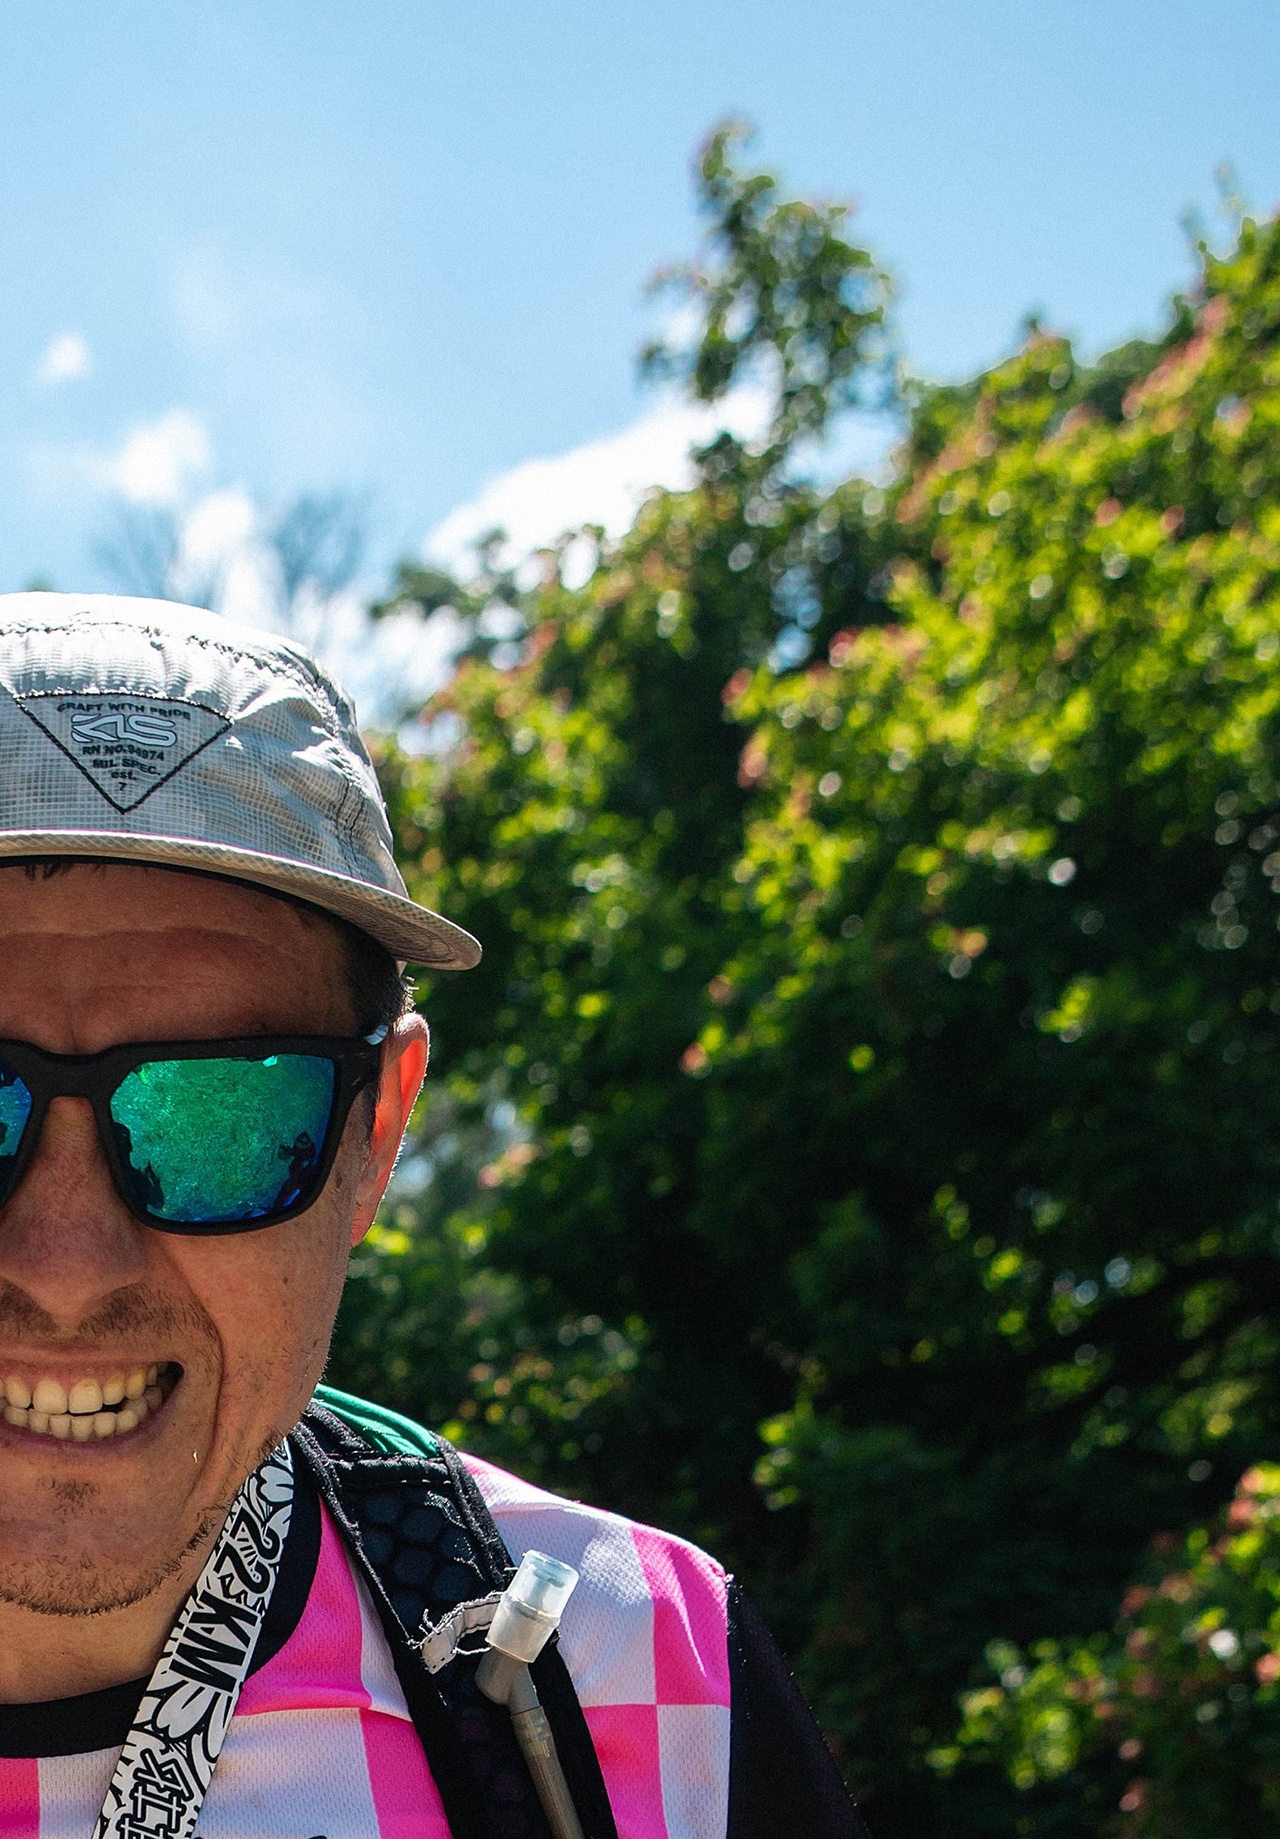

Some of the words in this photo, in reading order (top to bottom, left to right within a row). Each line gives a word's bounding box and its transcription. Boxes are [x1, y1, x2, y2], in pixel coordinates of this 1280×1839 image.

[56, 702, 104, 713] CRAFT
[107, 702, 145, 713] WITH
[149, 706, 192, 720] PRIDE
